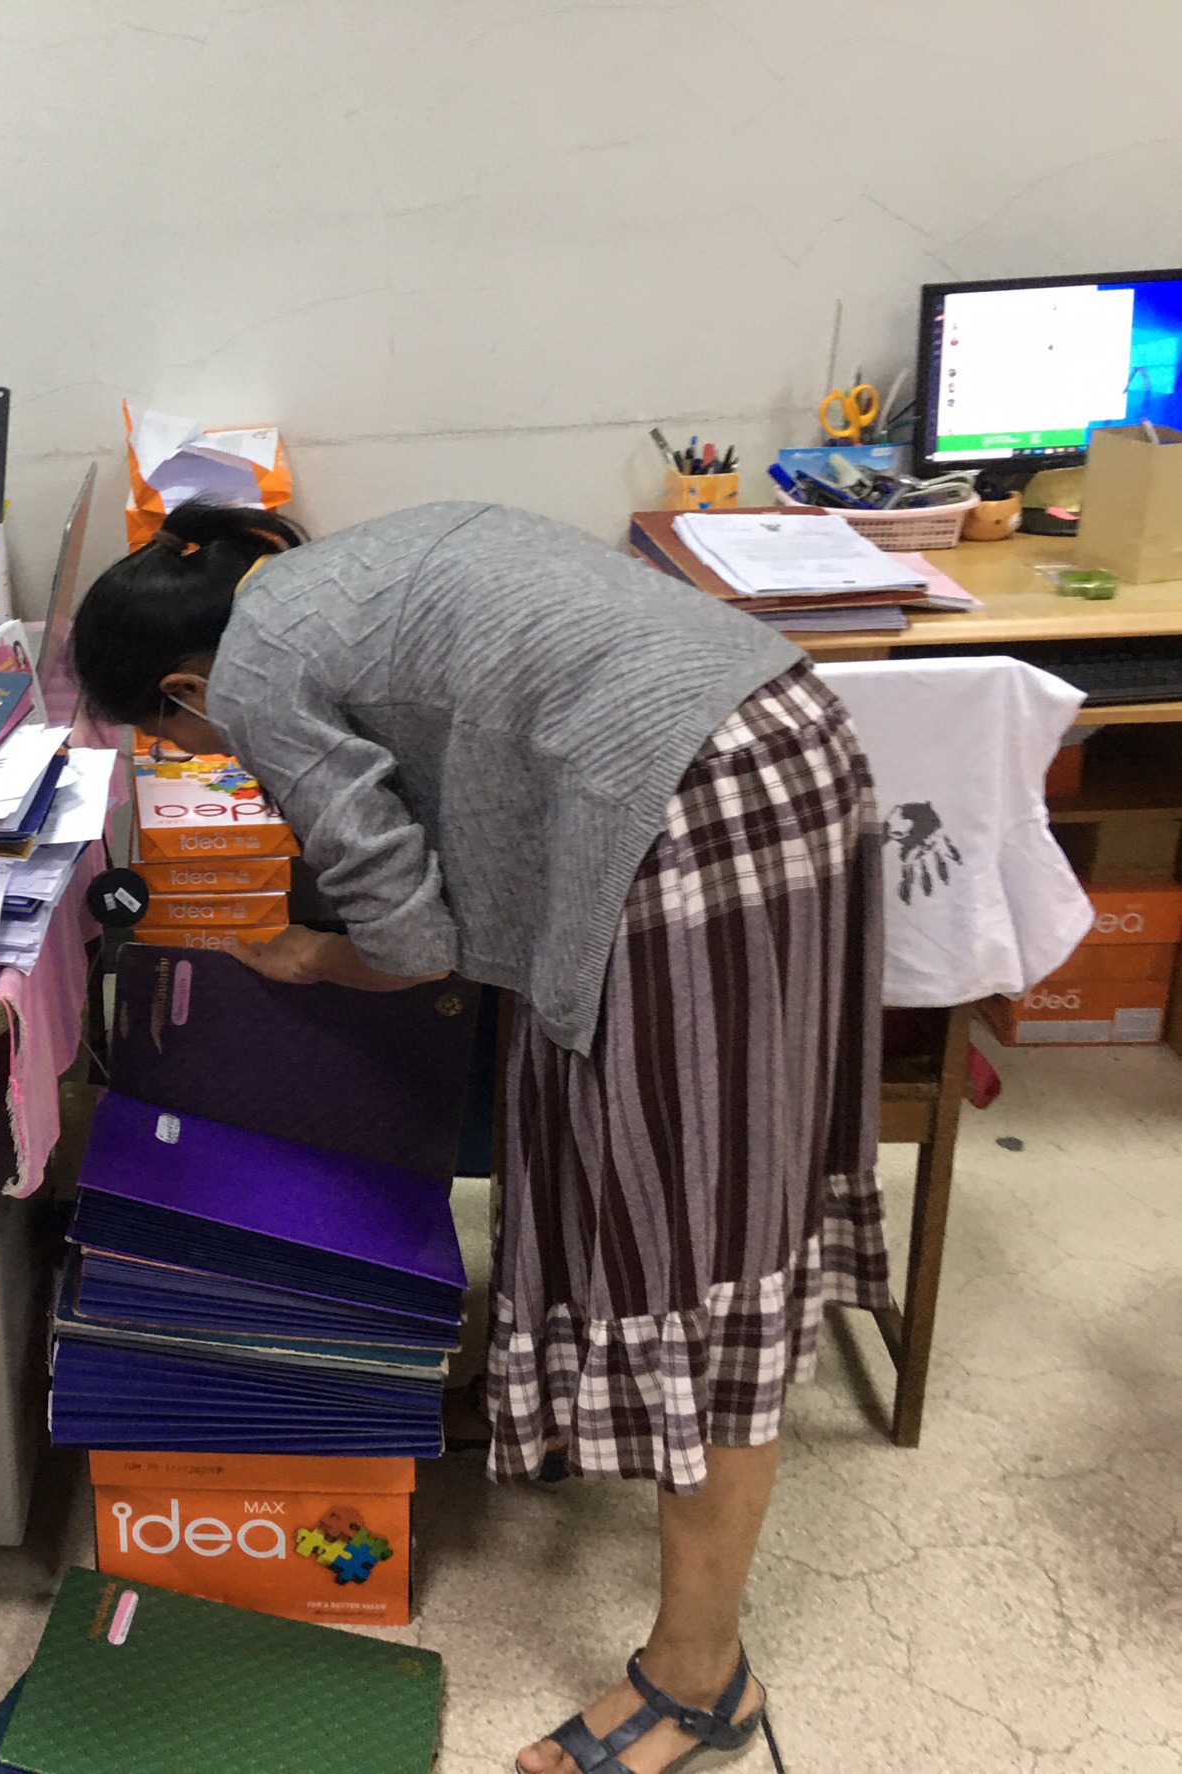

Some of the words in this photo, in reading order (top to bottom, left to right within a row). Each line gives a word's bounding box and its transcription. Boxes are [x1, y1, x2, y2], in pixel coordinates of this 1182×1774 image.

[179, 832, 227, 851] idea
[170, 867, 218, 886] idea
[168, 901, 215, 919] idea
[244, 1500, 286, 1514] MAX
[111, 1498, 286, 1560] idea
